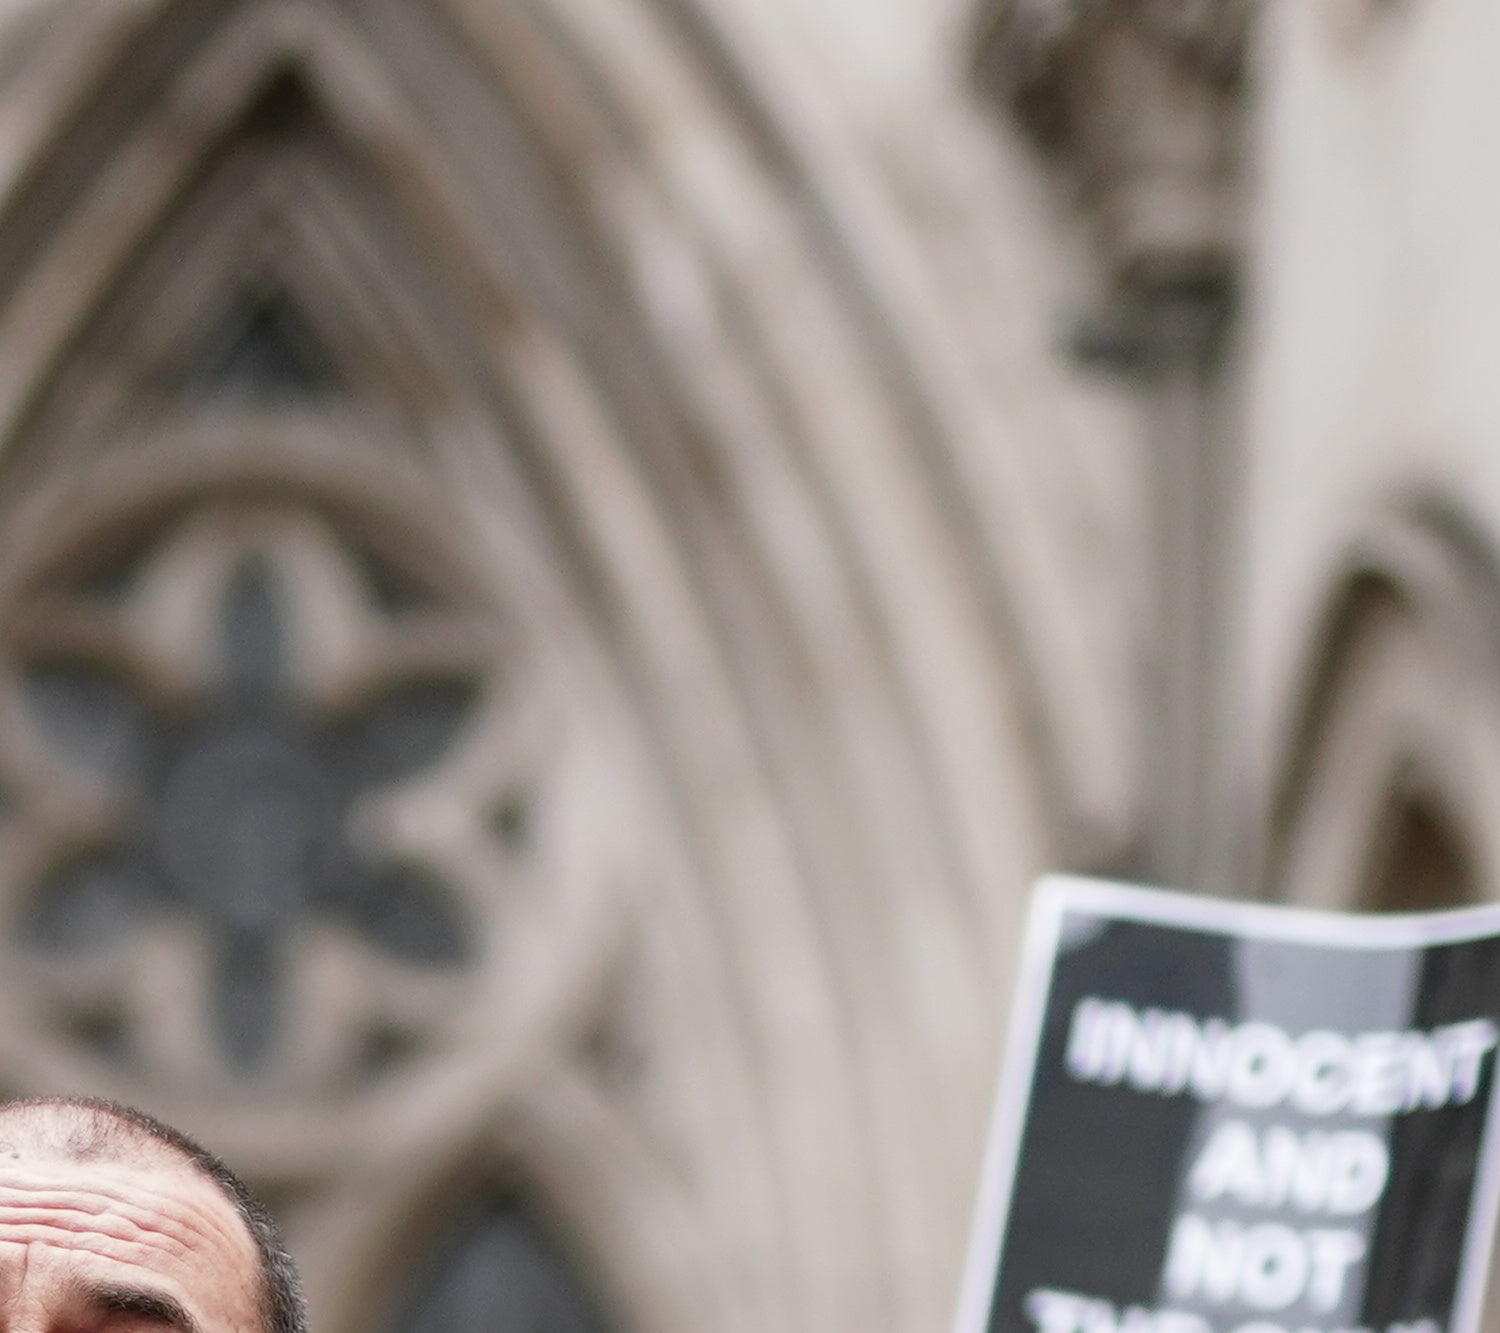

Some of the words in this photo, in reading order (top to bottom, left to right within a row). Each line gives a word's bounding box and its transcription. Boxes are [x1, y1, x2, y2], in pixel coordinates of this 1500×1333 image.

[1064, 994, 1499, 1117] INNOCENT
[1187, 1118, 1391, 1218] AND
[1162, 1214, 1363, 1316] NOT
